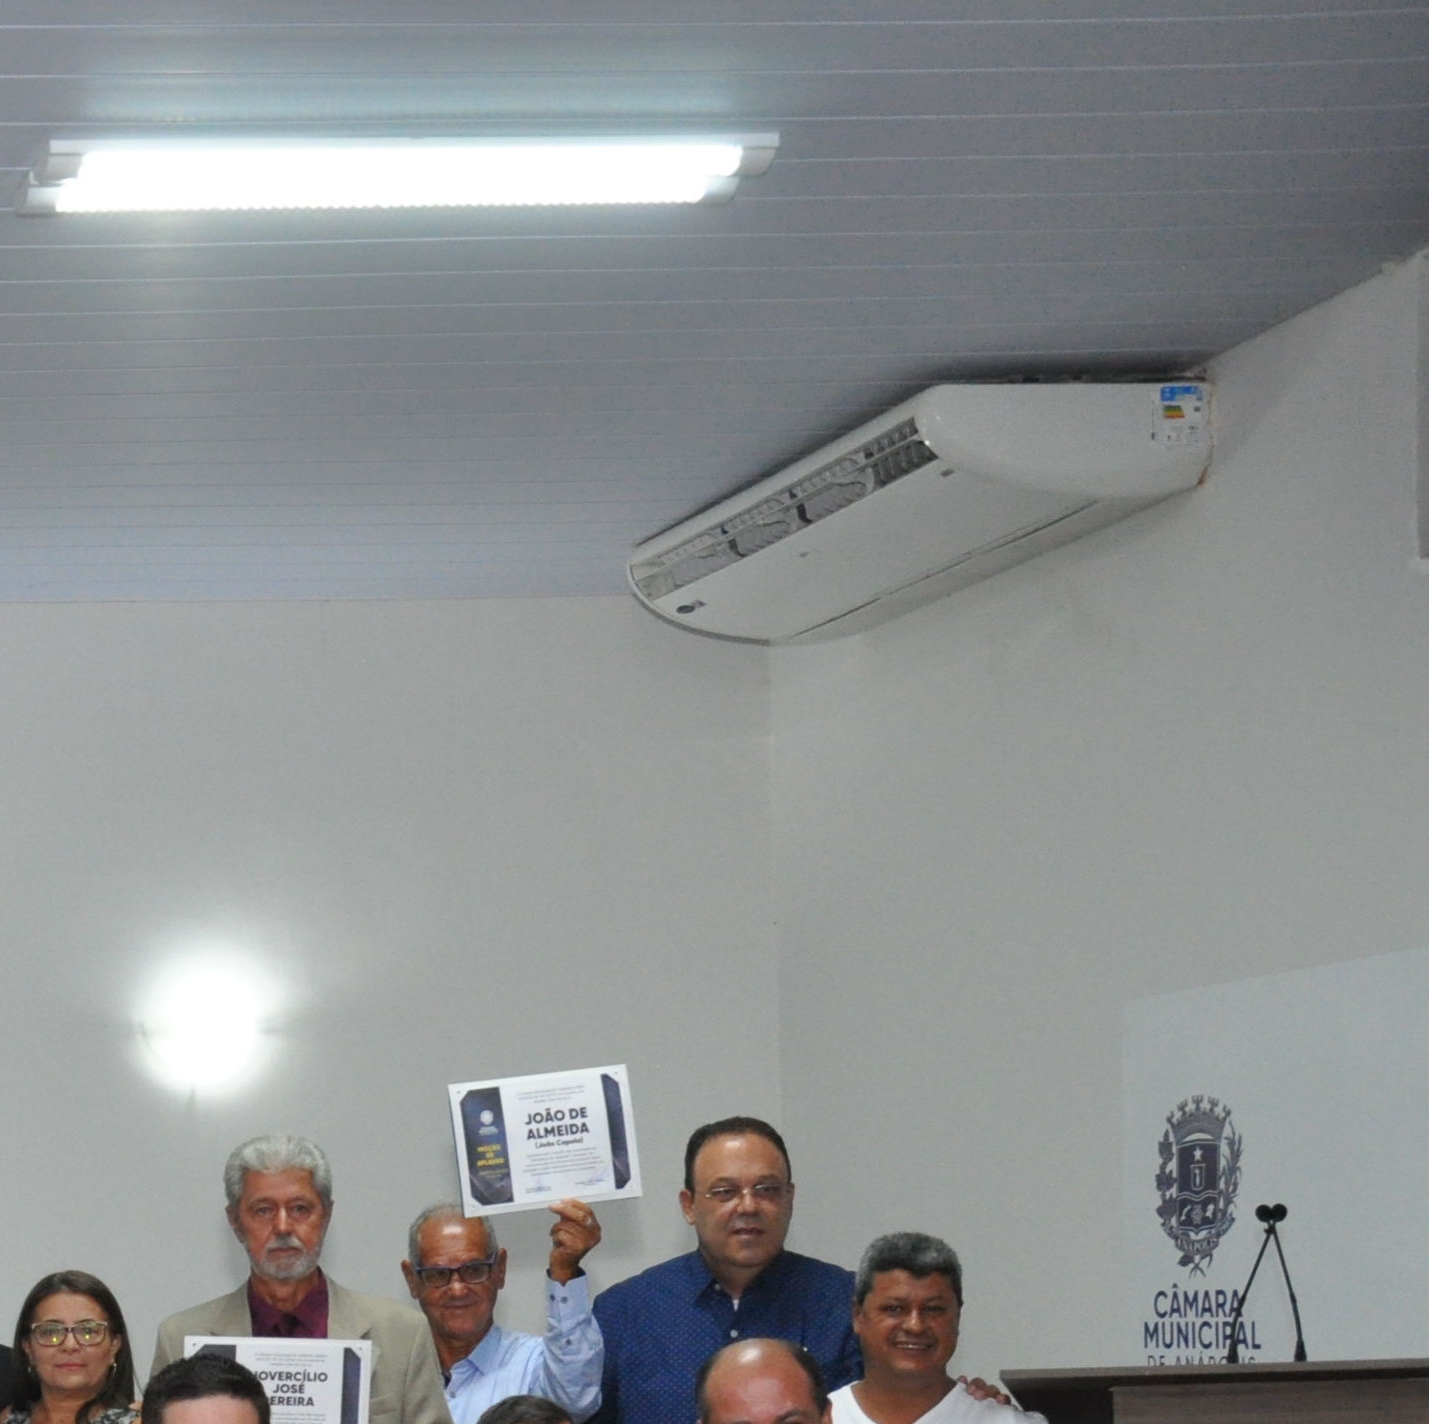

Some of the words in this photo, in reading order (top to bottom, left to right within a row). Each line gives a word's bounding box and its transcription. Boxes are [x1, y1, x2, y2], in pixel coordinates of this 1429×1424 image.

[525, 1108, 565, 1125] JOÃO
[569, 1107, 587, 1119] DE
[527, 1122, 589, 1140] ALMEIDA
[1153, 1283, 1242, 1318] CÂMARA
[1144, 1321, 1261, 1350] MUNICIPAL
[1175, 1350, 1256, 1366] ANÁPOIS
[273, 1379, 306, 1394] JOSÉ
[267, 1395, 313, 1406] EREIRA
